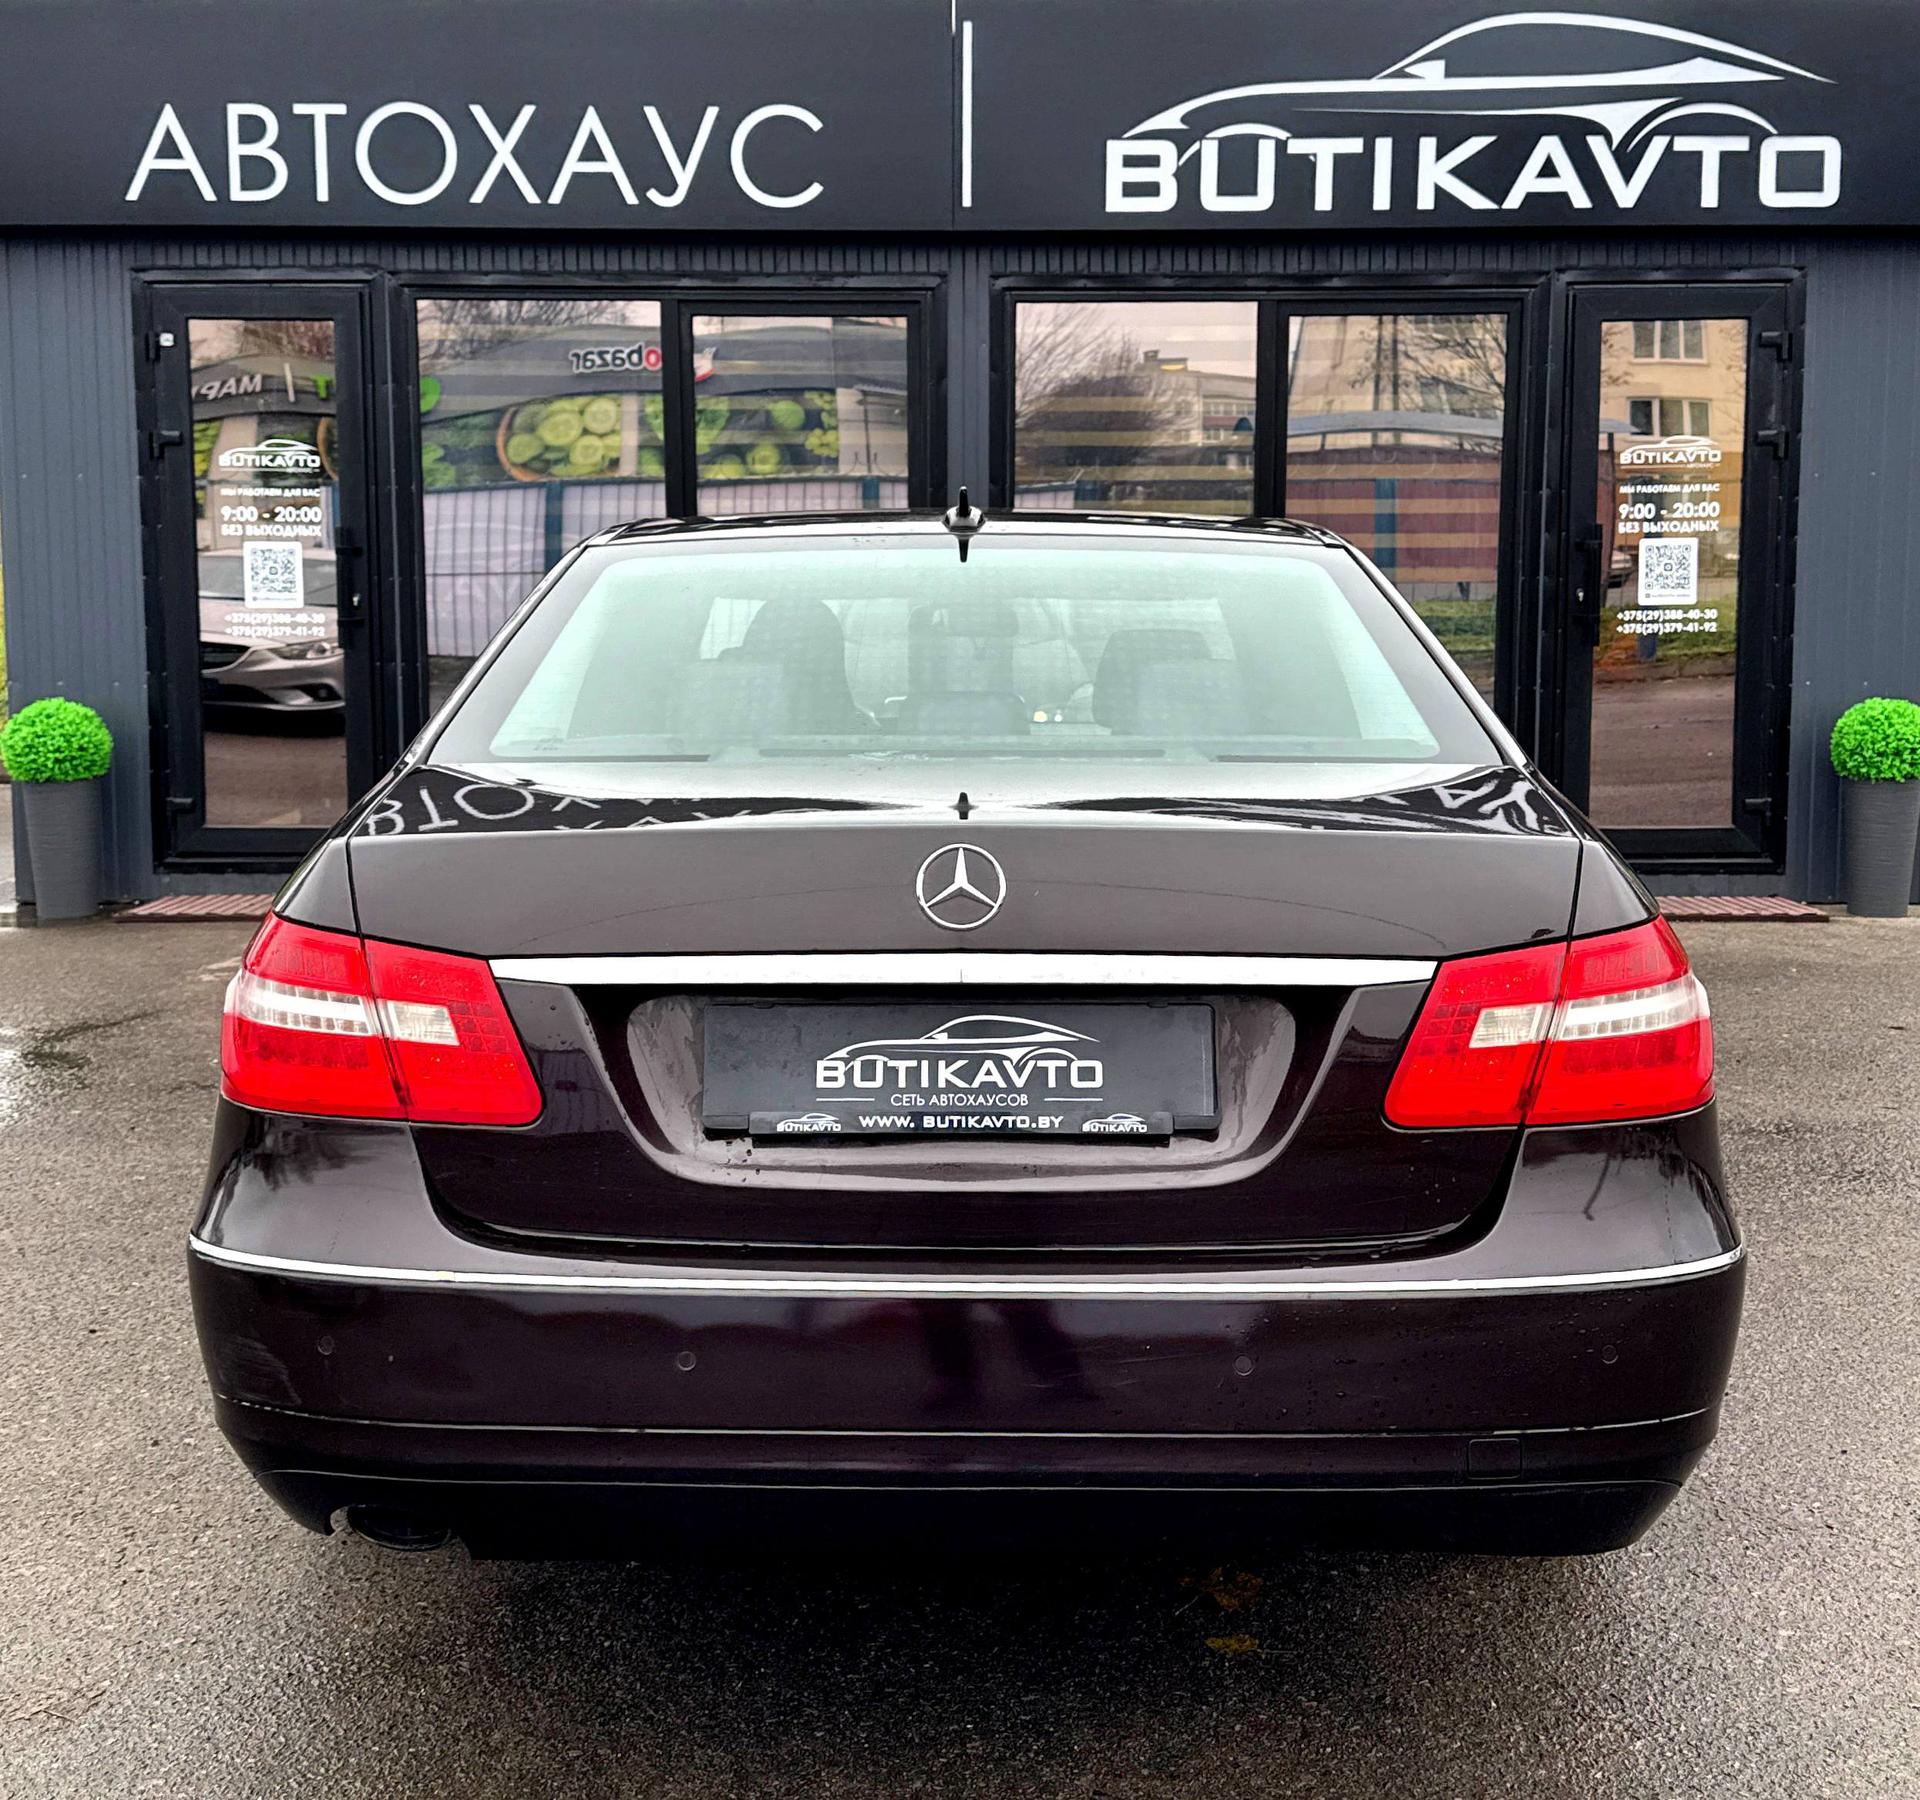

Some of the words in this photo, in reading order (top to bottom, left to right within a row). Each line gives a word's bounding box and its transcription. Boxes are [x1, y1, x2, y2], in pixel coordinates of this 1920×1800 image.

[125, 101, 824, 209] АВТОХАУС
[1105, 136, 1842, 213] BUTIKAVTO
[218, 453, 321, 467] BUTIKAVTO
[1619, 450, 1722, 465] BUTIKAVTO
[220, 505, 259, 522] 9:00
[273, 505, 322, 522] 20:00
[1618, 503, 1657, 519] 9:00
[1672, 501, 1721, 518] 20:00
[220, 523, 243, 536] БЕЗ
[245, 524, 322, 537] ВЫХОДНЫХ
[1618, 521, 1640, 534] БЕЗ
[1642, 520, 1719, 533] ВЫХОДНЫХ
[1616, 621, 1718, 636] +375(29)379-41-92
[815, 1060, 1104, 1089] BUTIKAVTO
[890, 1093, 925, 1106] СЕТЬ
[929, 1093, 1029, 1106] АВТОХАУСОВ
[776, 1123, 842, 1132] BUTIKAVTO
[858, 1115, 915, 1128] WWW.
[923, 1115, 1064, 1129] BUTIKAVTO.BY
[1082, 1123, 1148, 1133] BUTIKAVTO
